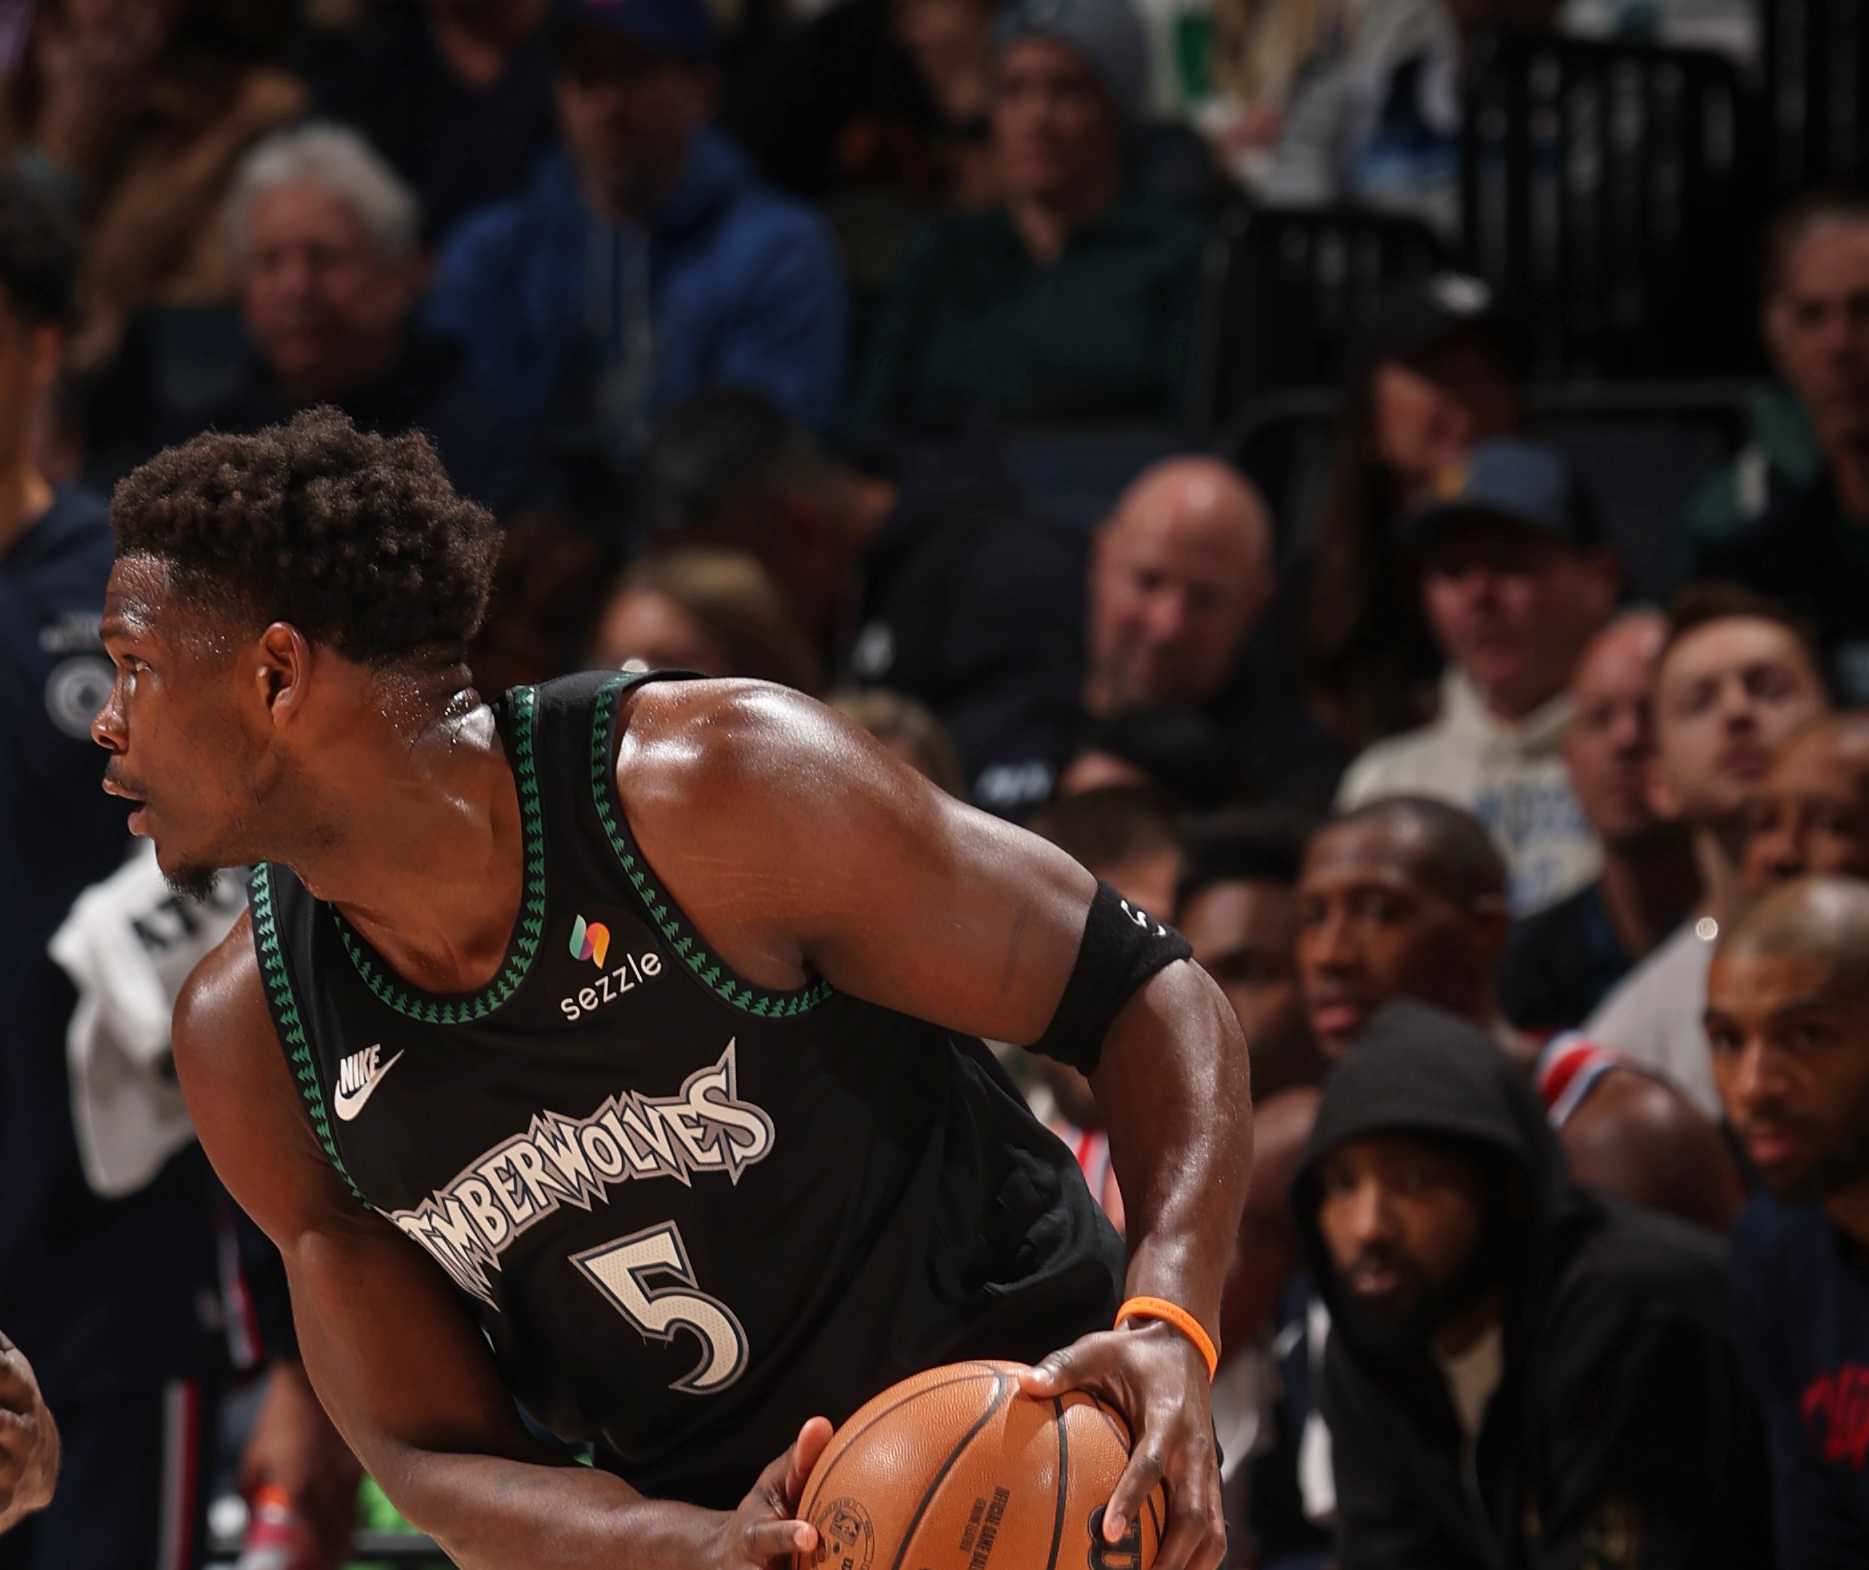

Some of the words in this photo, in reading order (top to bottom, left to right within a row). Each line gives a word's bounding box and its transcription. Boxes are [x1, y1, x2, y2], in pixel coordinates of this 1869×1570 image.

[560, 952, 662, 1021] sezzle
[339, 1043, 382, 1096] NIKE
[568, 1219, 750, 1395] 5
